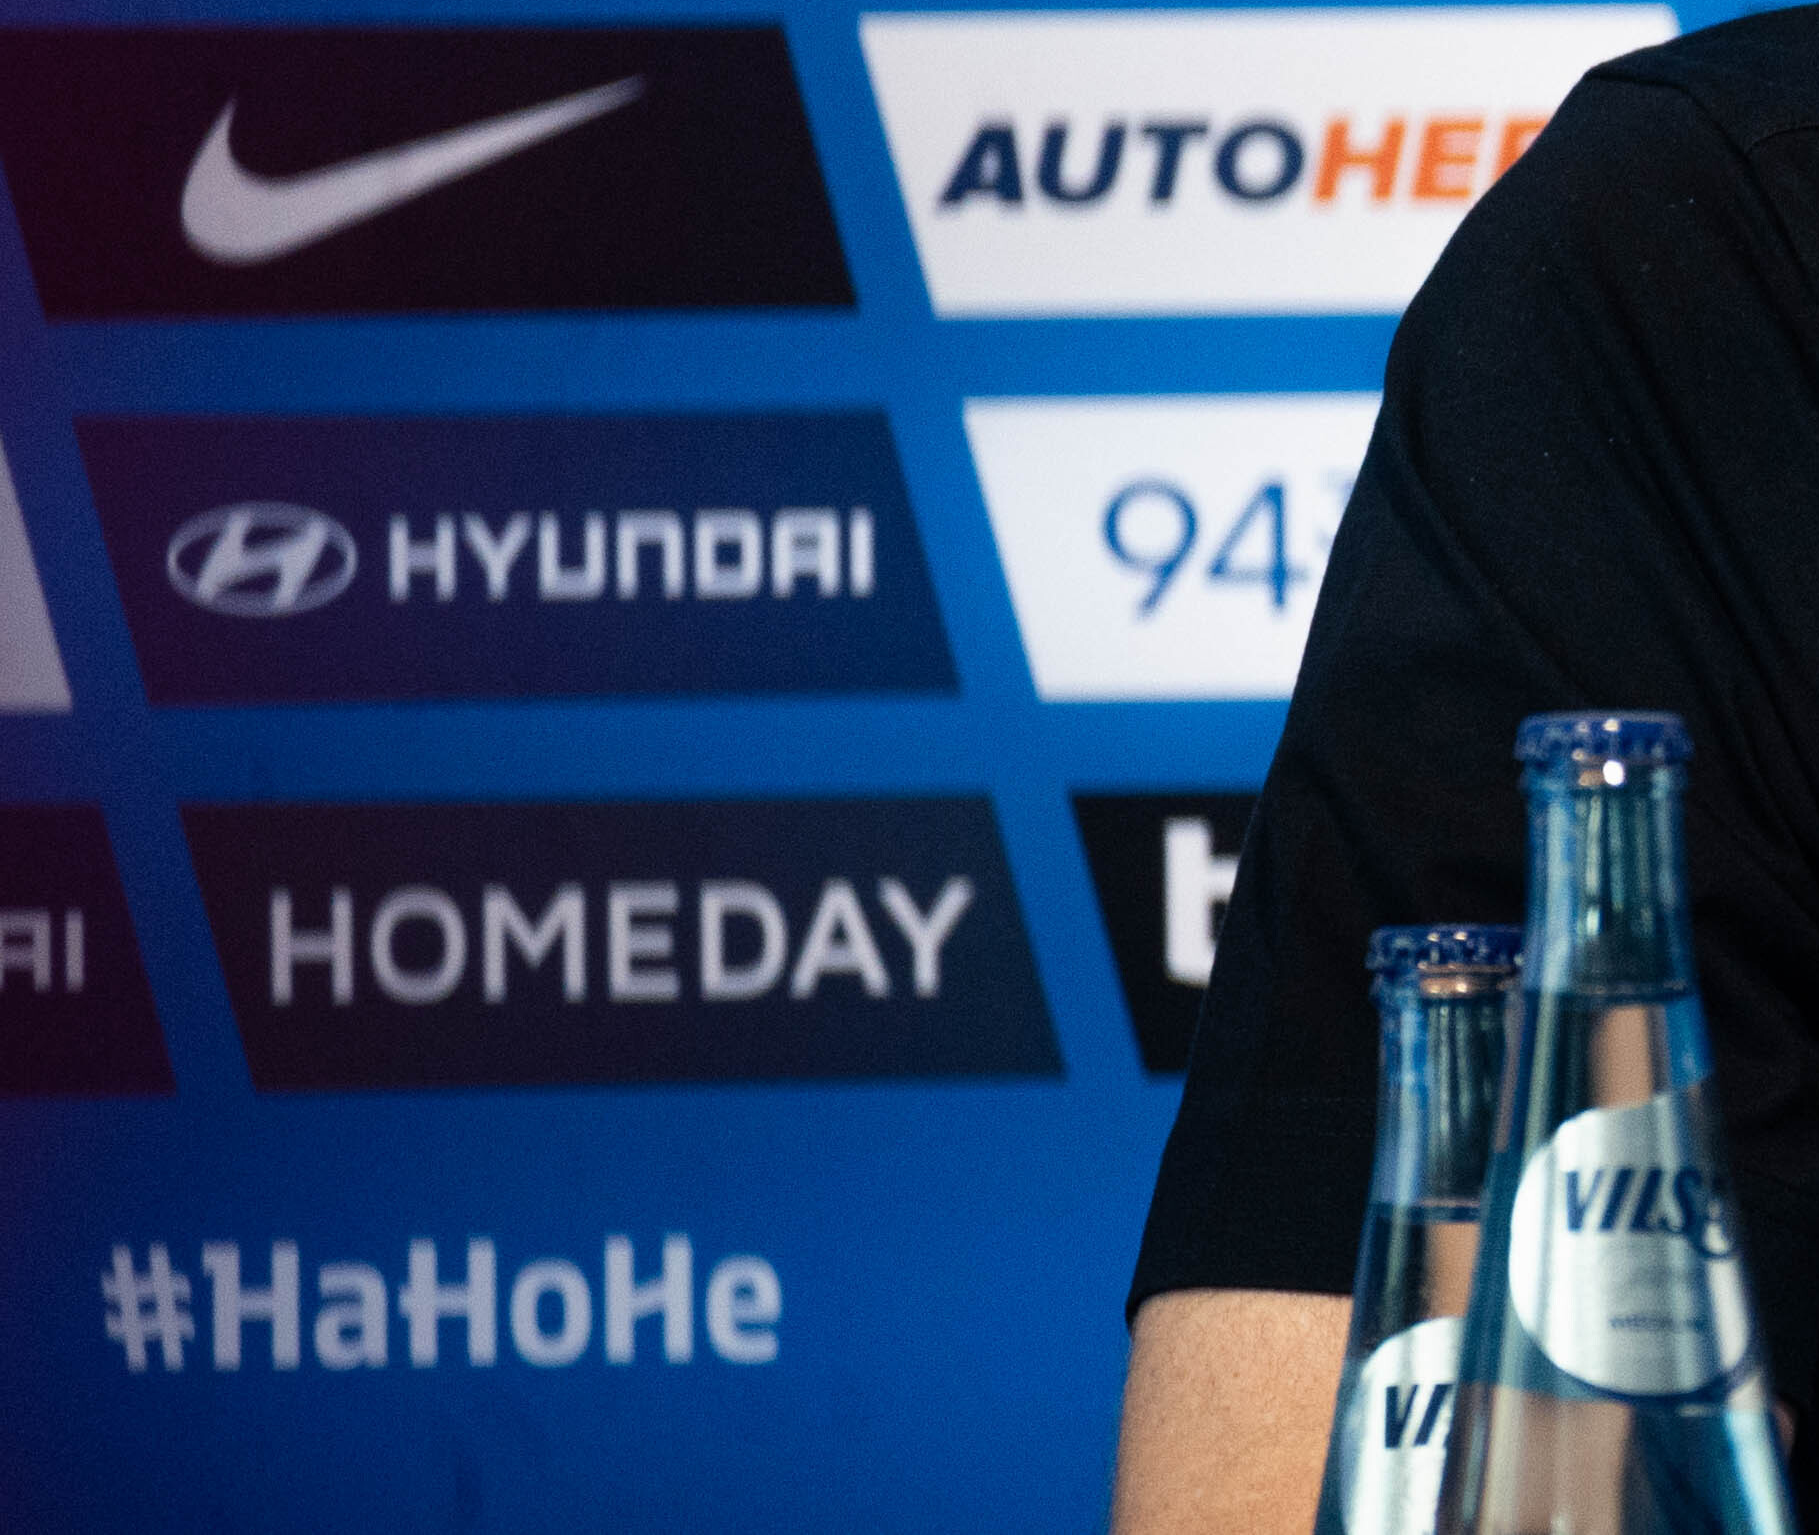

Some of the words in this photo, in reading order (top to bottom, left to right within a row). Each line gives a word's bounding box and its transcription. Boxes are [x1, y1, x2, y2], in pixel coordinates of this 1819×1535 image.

[389, 508, 873, 601] HYUNDAI
[271, 877, 972, 1006] HOMEDAY
[104, 1234, 784, 1372] #HaHoHe
